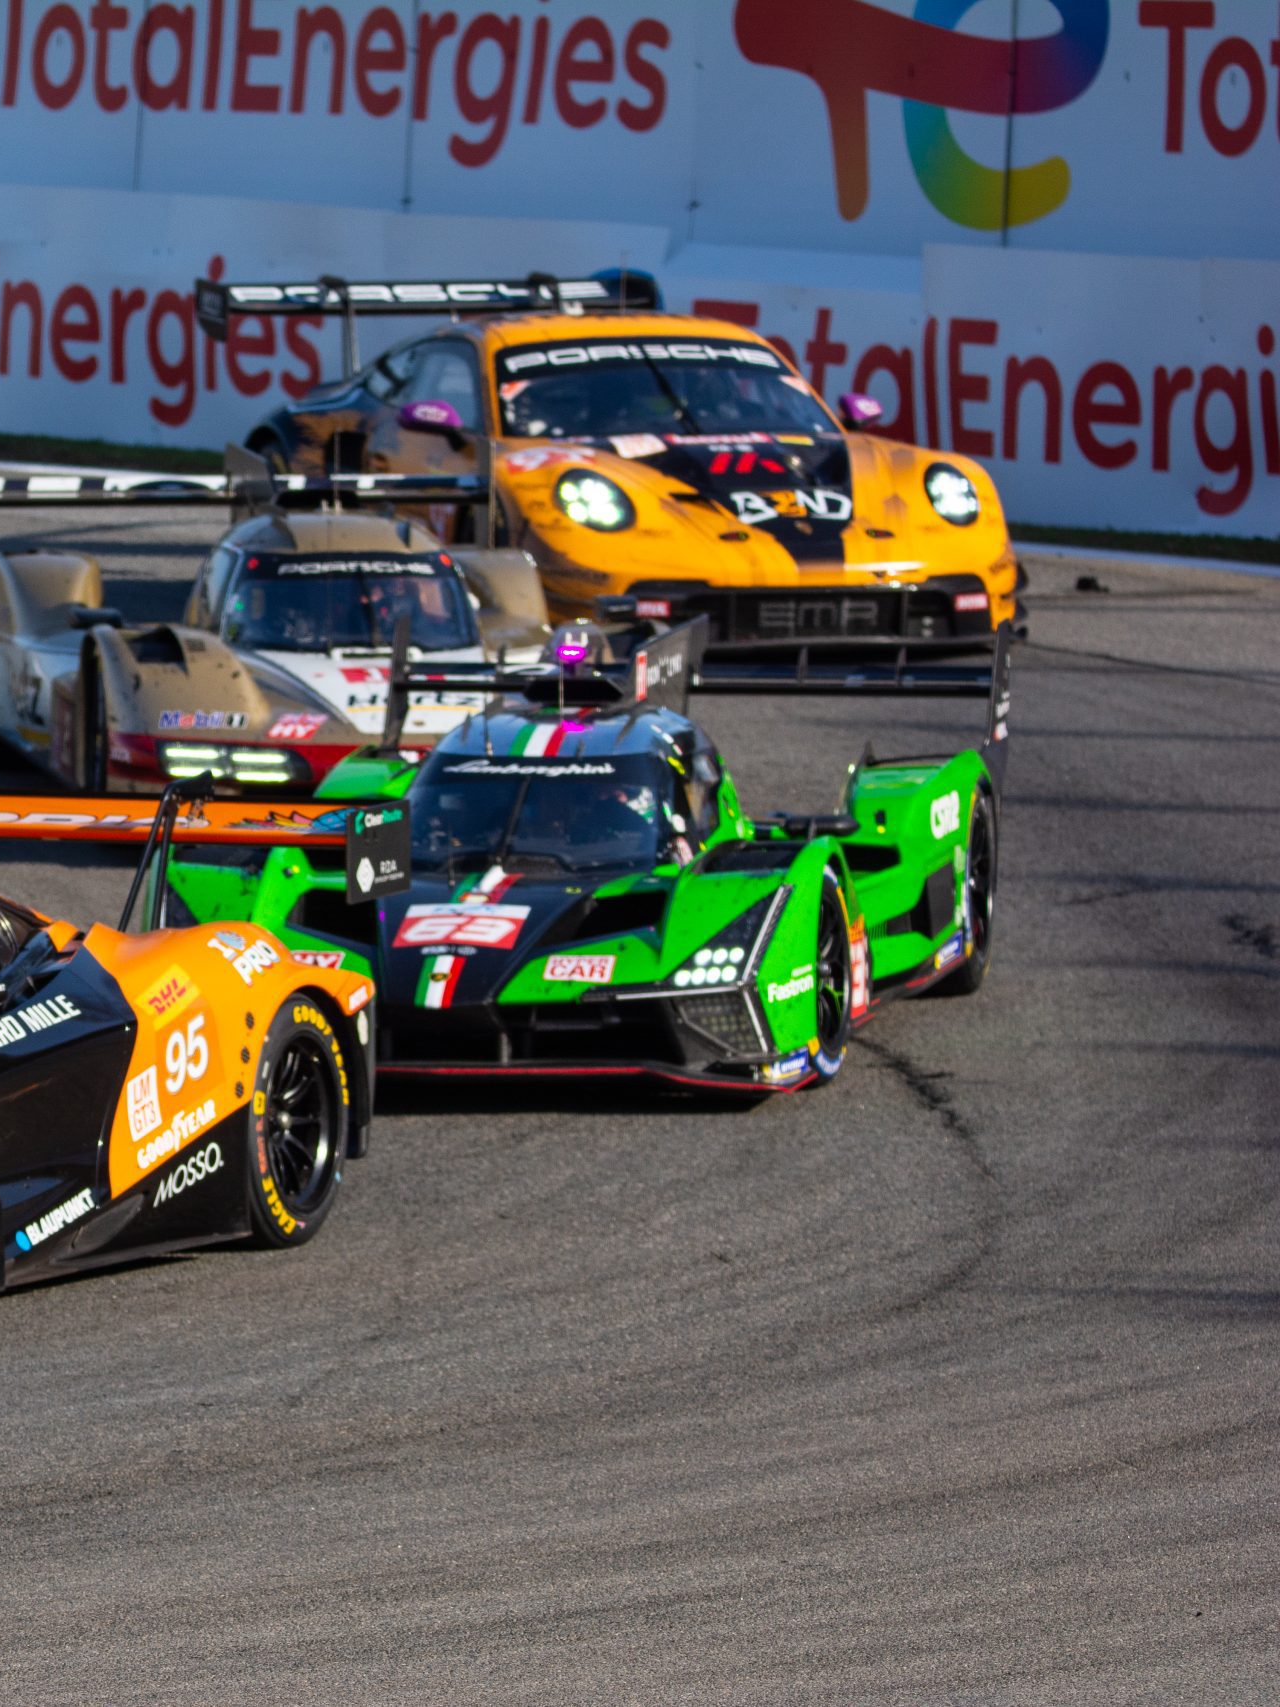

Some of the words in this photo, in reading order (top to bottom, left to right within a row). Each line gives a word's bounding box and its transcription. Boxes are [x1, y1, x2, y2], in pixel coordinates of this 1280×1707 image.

[1138, 1, 1280, 159] To
[505, 344, 780, 373] PORSCHE
[693, 298, 1280, 517] talEnergi
[348, 692, 481, 707] Hrtz
[443, 759, 616, 777] Lamborghini
[401, 916, 516, 943] 63
[549, 964, 606, 978] CAR
[17, 993, 82, 1033] MILLE
[148, 978, 188, 1016] DHL
[165, 1013, 209, 1095] 95
[137, 1099, 217, 1169] GOODYEAR
[25, 1187, 96, 1247] BLAUPUNKT
